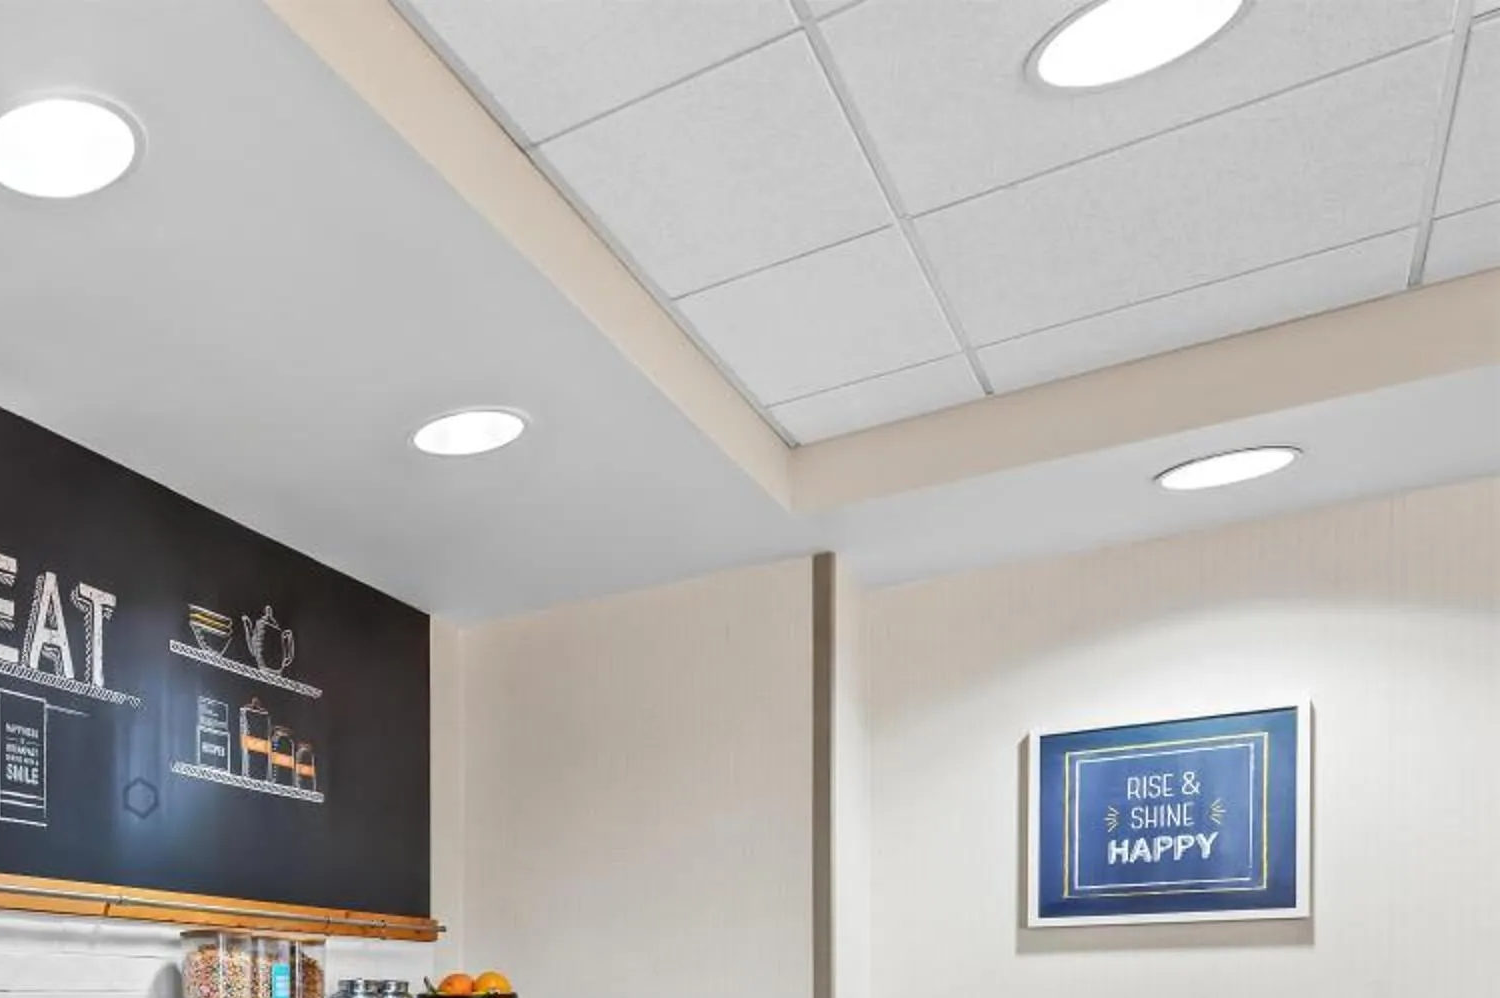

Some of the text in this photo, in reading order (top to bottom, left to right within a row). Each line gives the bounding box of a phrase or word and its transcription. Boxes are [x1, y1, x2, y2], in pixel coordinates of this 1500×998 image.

[5, 763, 40, 785] SMILE
[1127, 771, 1201, 800] RISE &
[1131, 801, 1195, 830] SHINE
[1107, 831, 1219, 865] HAPPY
